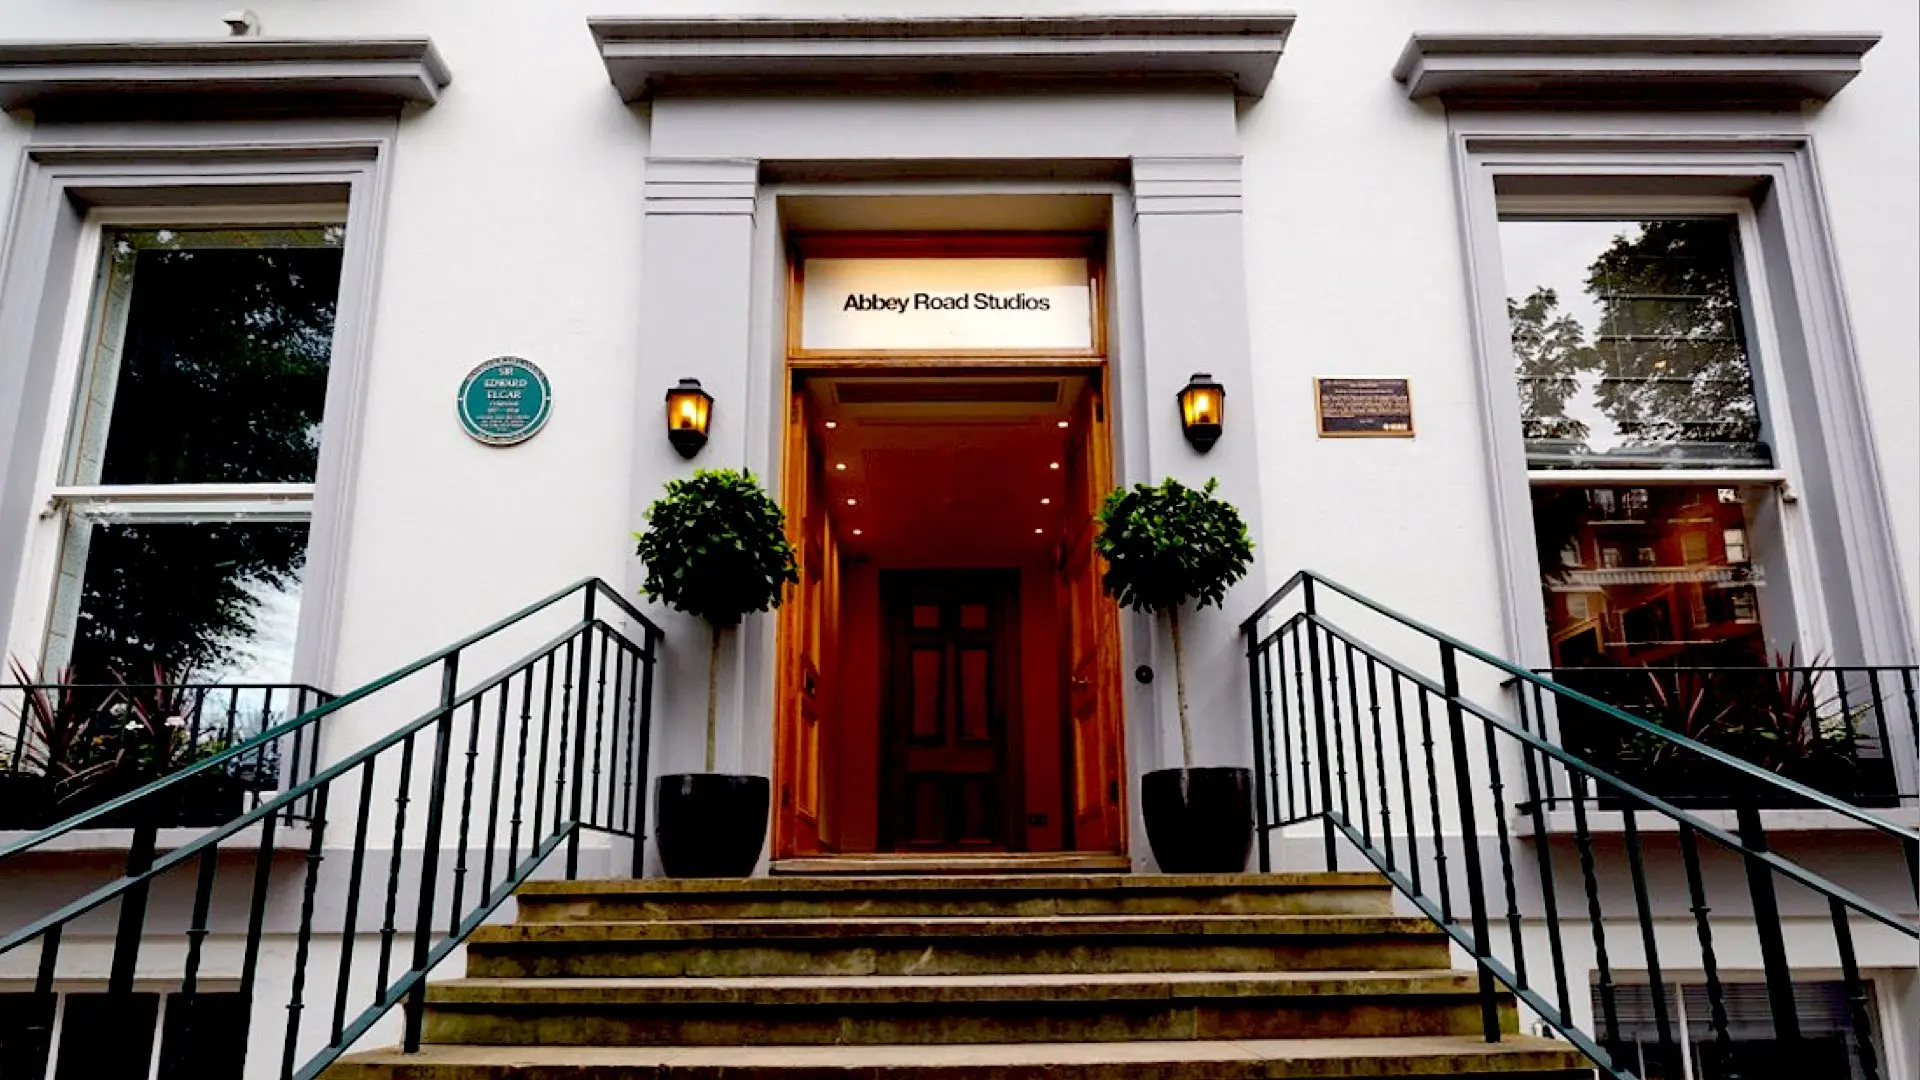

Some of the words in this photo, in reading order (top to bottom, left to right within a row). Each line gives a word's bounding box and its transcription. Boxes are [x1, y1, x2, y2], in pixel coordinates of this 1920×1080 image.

[843, 294, 909, 313] Abbey
[914, 293, 969, 310] Road
[974, 293, 1050, 310] Studios
[484, 378, 528, 387] EDWARD
[487, 390, 521, 399] ELGAR
